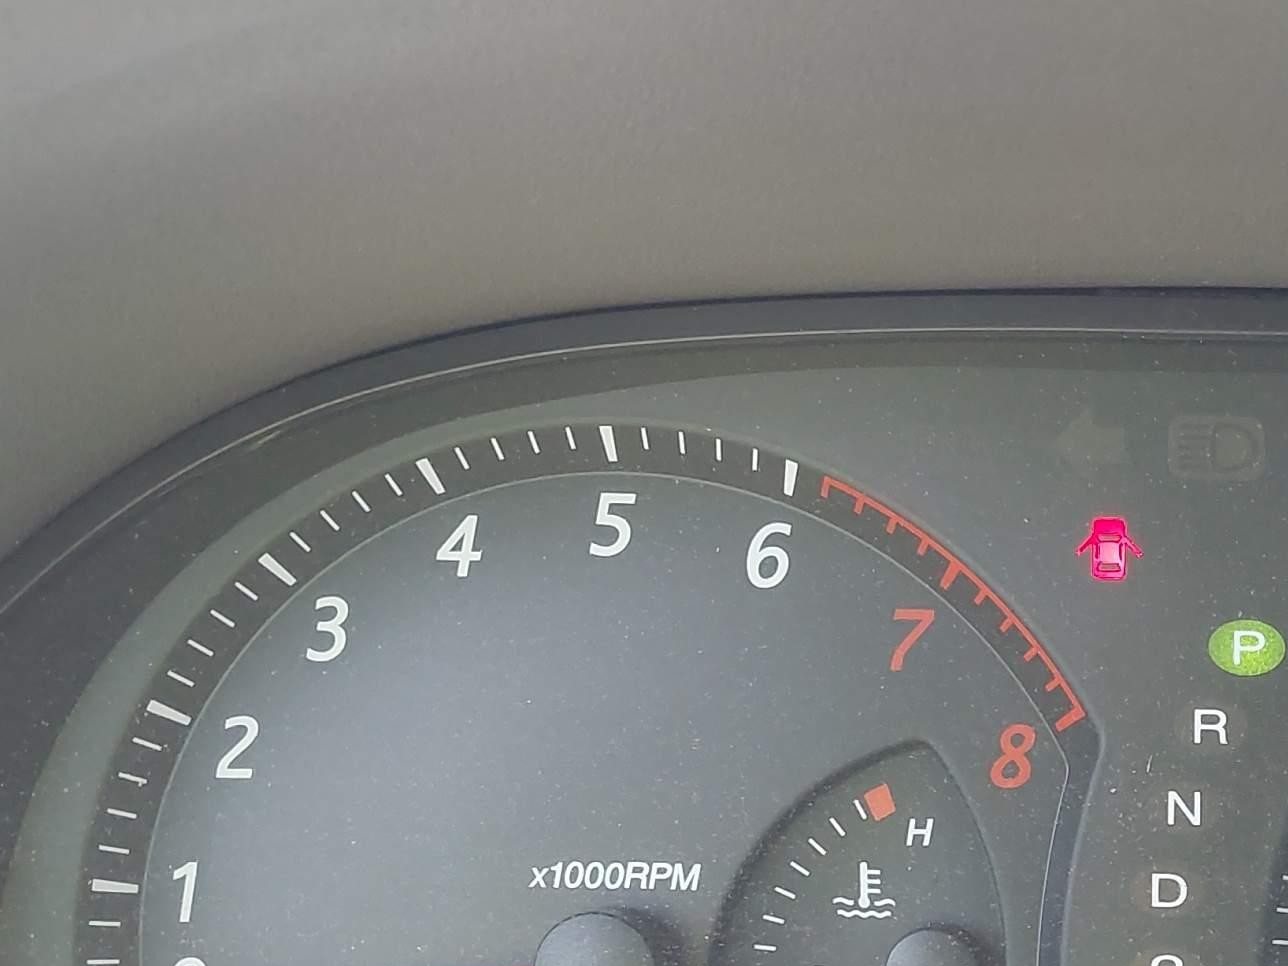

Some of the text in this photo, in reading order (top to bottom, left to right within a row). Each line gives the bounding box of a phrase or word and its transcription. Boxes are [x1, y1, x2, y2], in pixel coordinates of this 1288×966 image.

[436, 515, 482, 577] 4
[590, 492, 636, 556] 5
[746, 522, 792, 588] 6
[306, 597, 349, 661] 3
[891, 609, 934, 671] 7
[1232, 630, 1265, 665] P
[216, 715, 259, 778] 2
[990, 724, 1035, 788] 8
[1193, 709, 1227, 743] R
[906, 819, 934, 846] H
[1167, 791, 1201, 825] N
[173, 862, 198, 922] 1
[529, 862, 701, 890] x1000RPM
[1151, 874, 1187, 907] D
